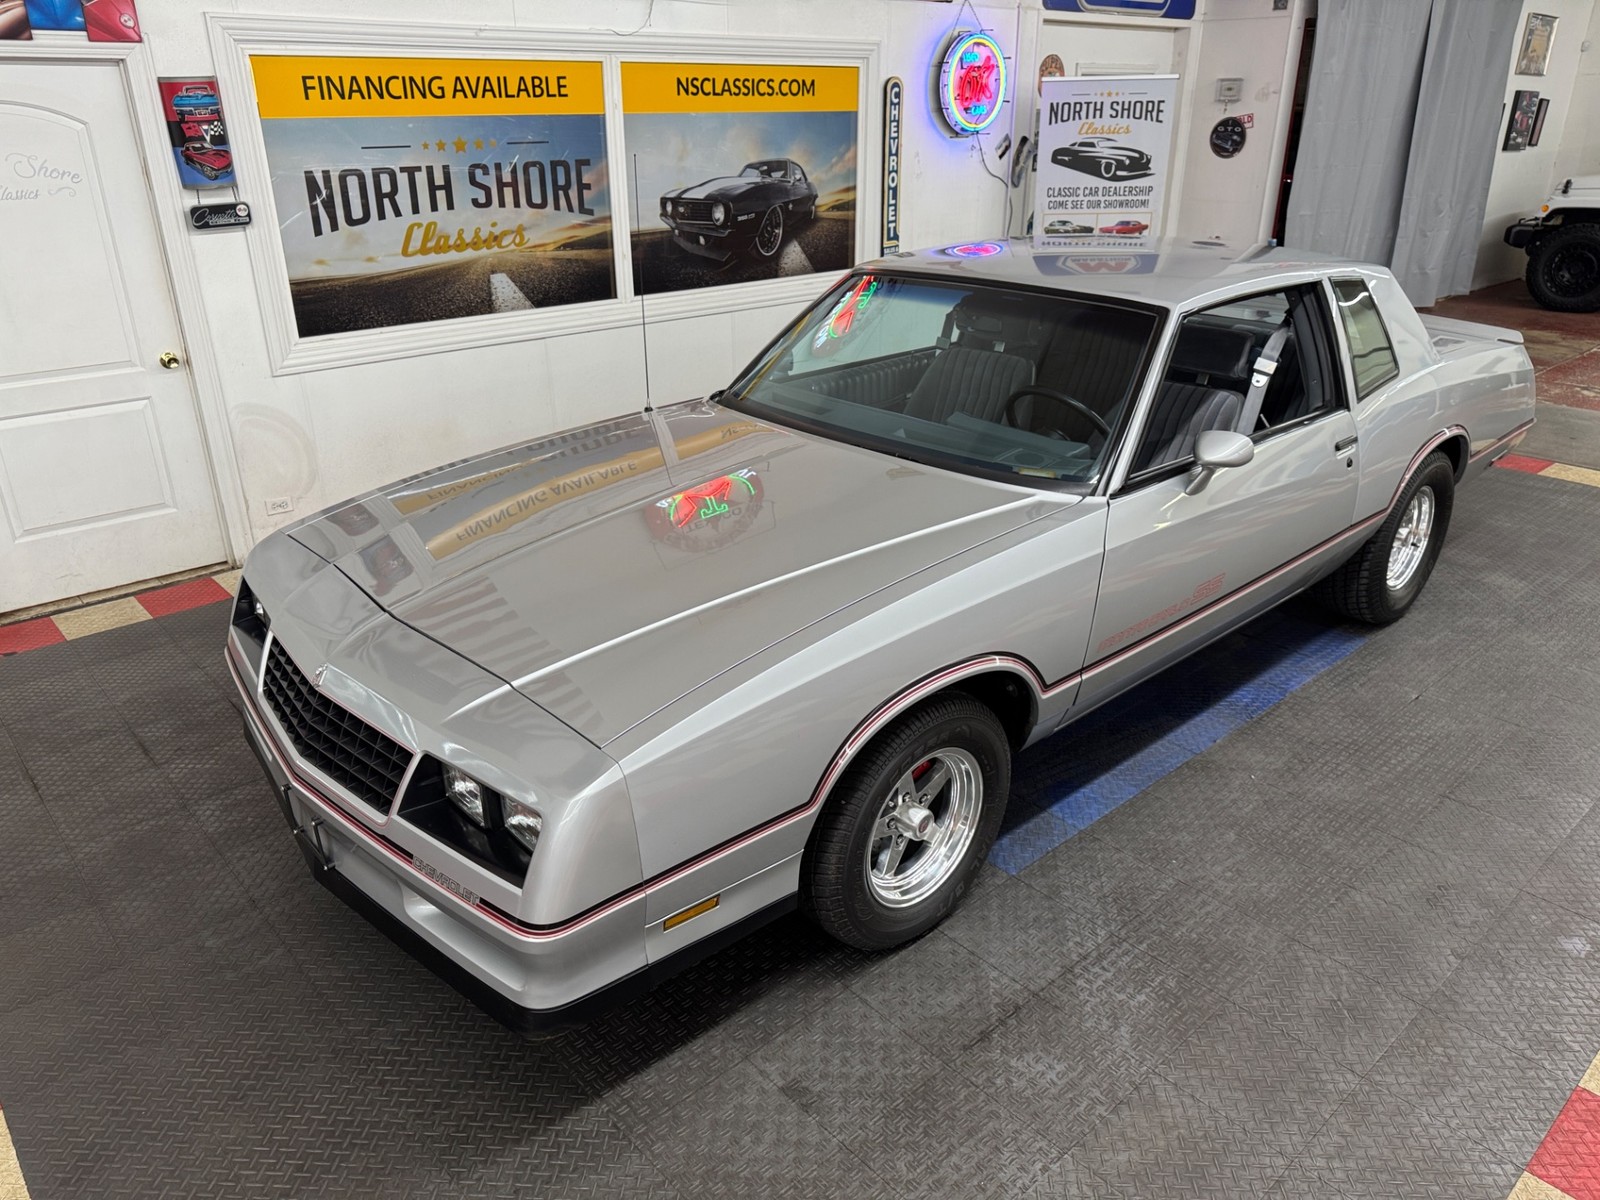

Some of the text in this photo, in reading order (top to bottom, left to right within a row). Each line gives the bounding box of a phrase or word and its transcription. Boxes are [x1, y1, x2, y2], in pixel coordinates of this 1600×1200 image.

[301, 75, 569, 101] FINANCING AVAILABLE
[676, 77, 816, 98] NSCLASSICS.COM
[1049, 100, 1165, 126] NORTH SHORE
[1078, 121, 1132, 136] Classics
[5, 152, 83, 184] Shore
[888, 87, 900, 238] CHEVROLET
[303, 158, 595, 237] NORTH SHORE
[1046, 185, 1154, 198] CLASSIC CAR DEALERSHIP
[1047, 199, 1150, 210] COME SEE OUR SHOWROOM!
[400, 221, 532, 258] Classics
[413, 855, 480, 906] CHEVROLET
